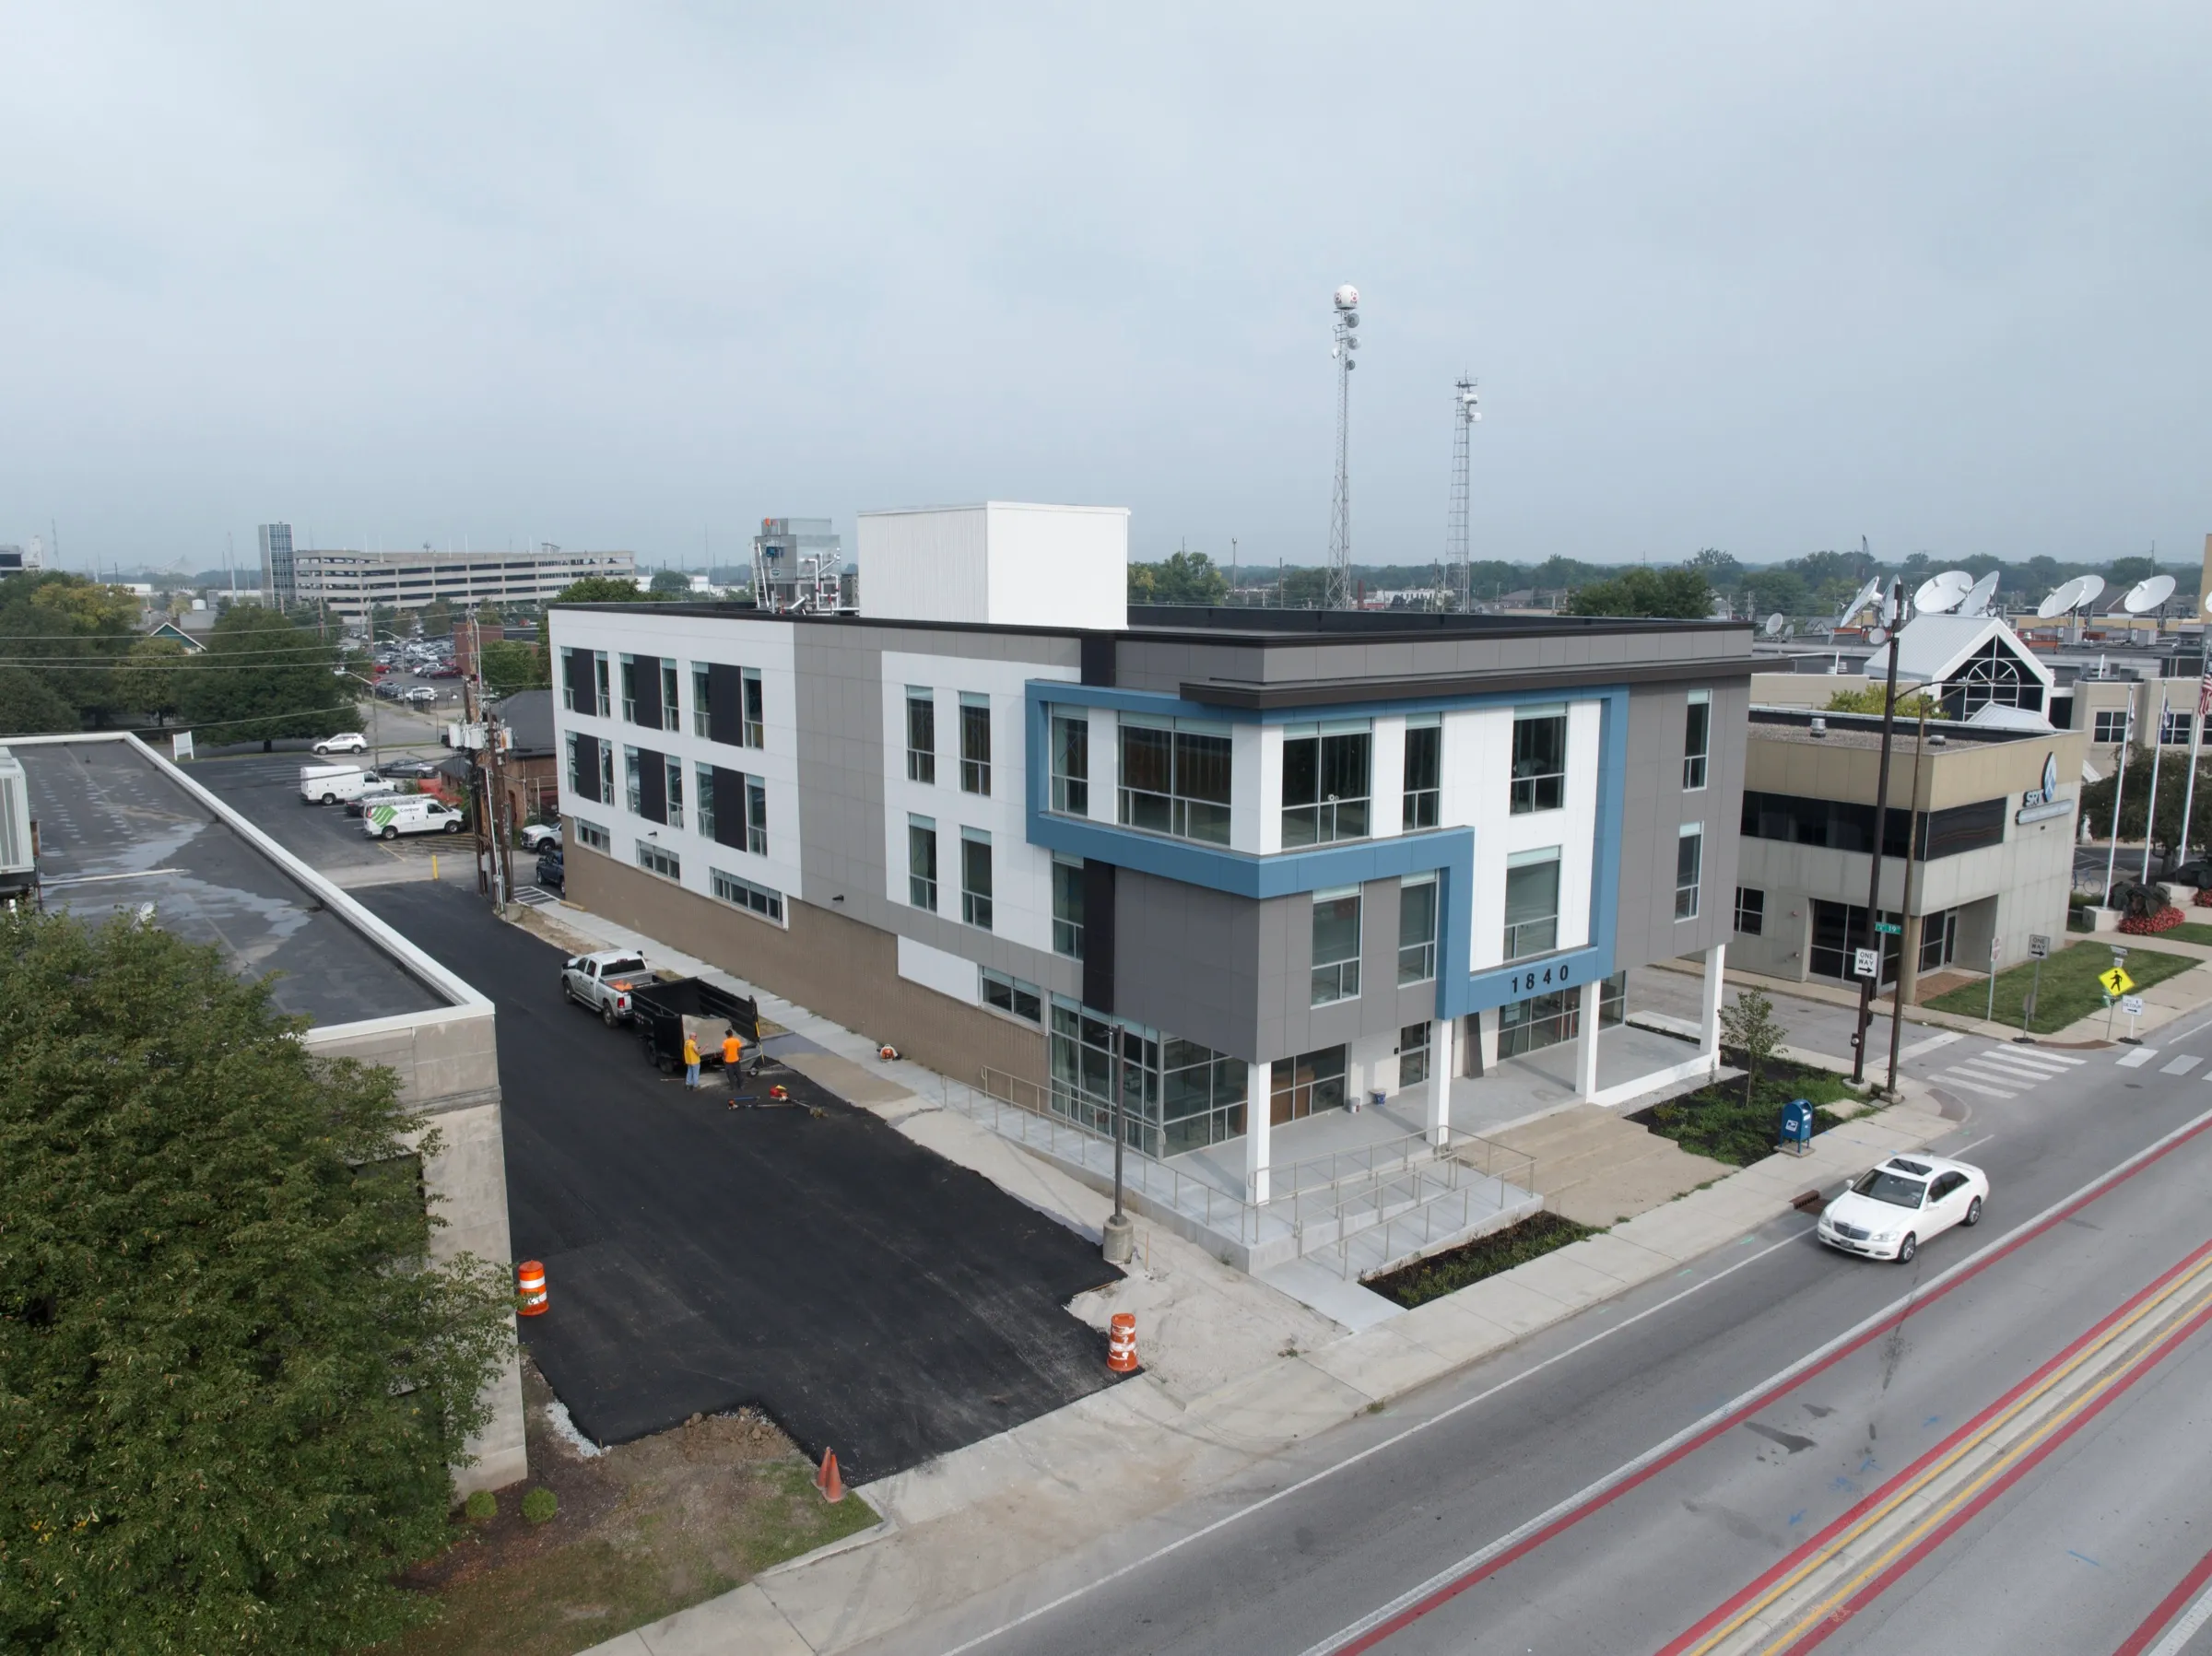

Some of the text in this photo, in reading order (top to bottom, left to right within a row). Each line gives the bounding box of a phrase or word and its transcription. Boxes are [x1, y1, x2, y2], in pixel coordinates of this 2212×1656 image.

[2031, 936, 2045, 945] ONE
[1859, 951, 1874, 959] ONE
[1512, 965, 1569, 993] 1840
